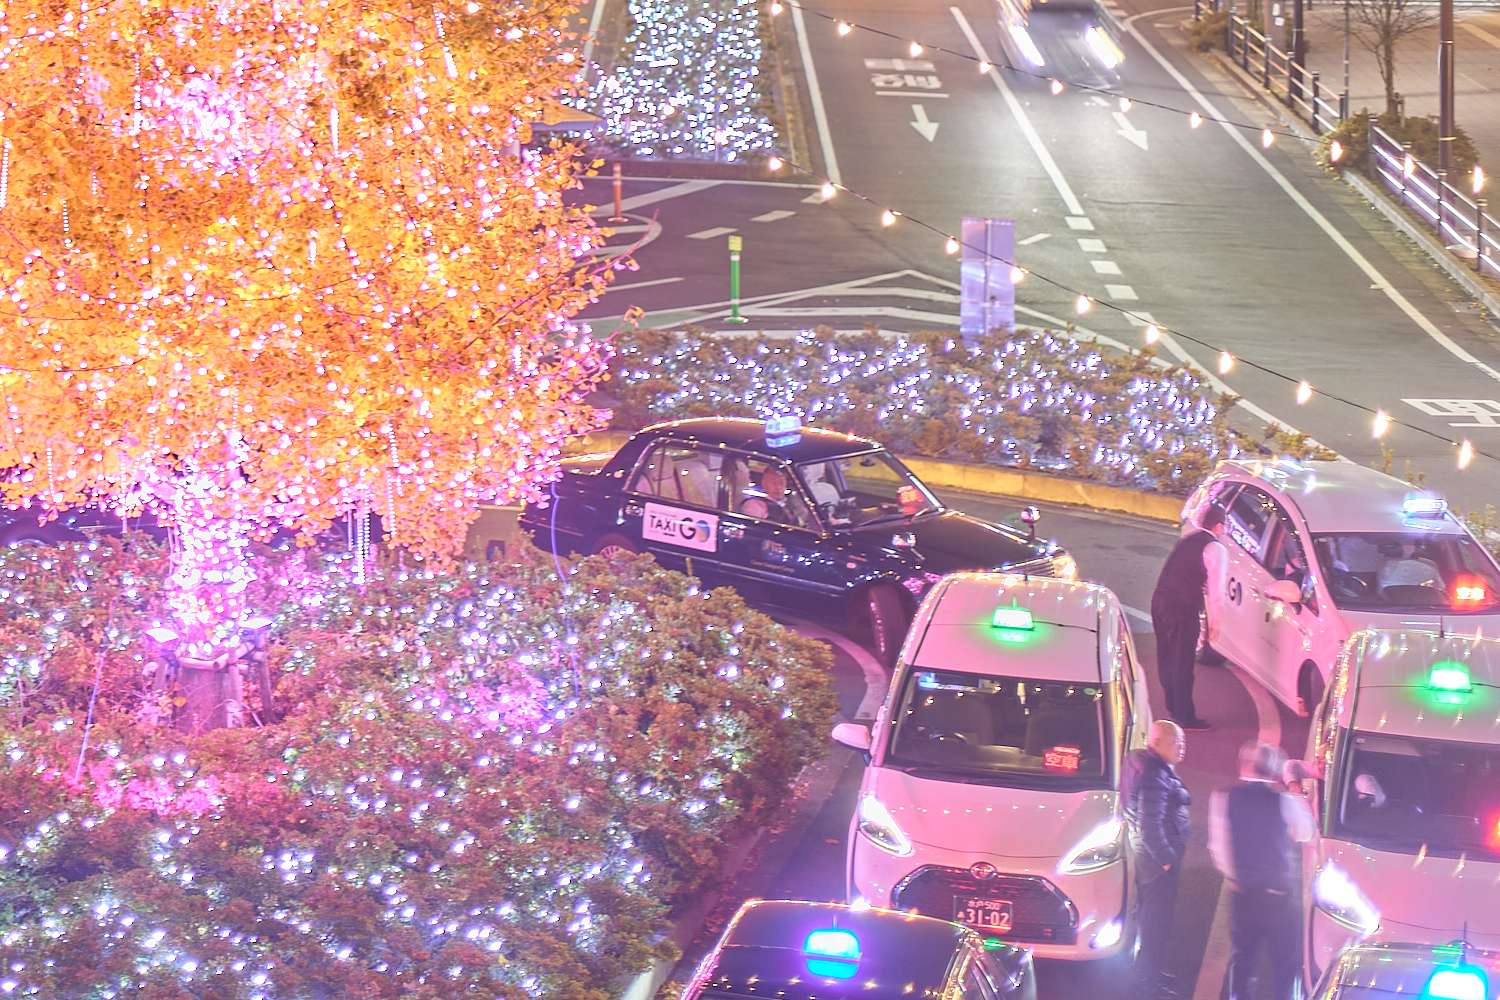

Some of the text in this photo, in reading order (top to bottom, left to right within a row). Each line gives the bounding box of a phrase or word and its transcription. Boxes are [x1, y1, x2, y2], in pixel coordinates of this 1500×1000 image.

[650, 516, 676, 533] TAXI
[1045, 753, 1079, 770] 空車
[966, 908, 1010, 927] 31-02
